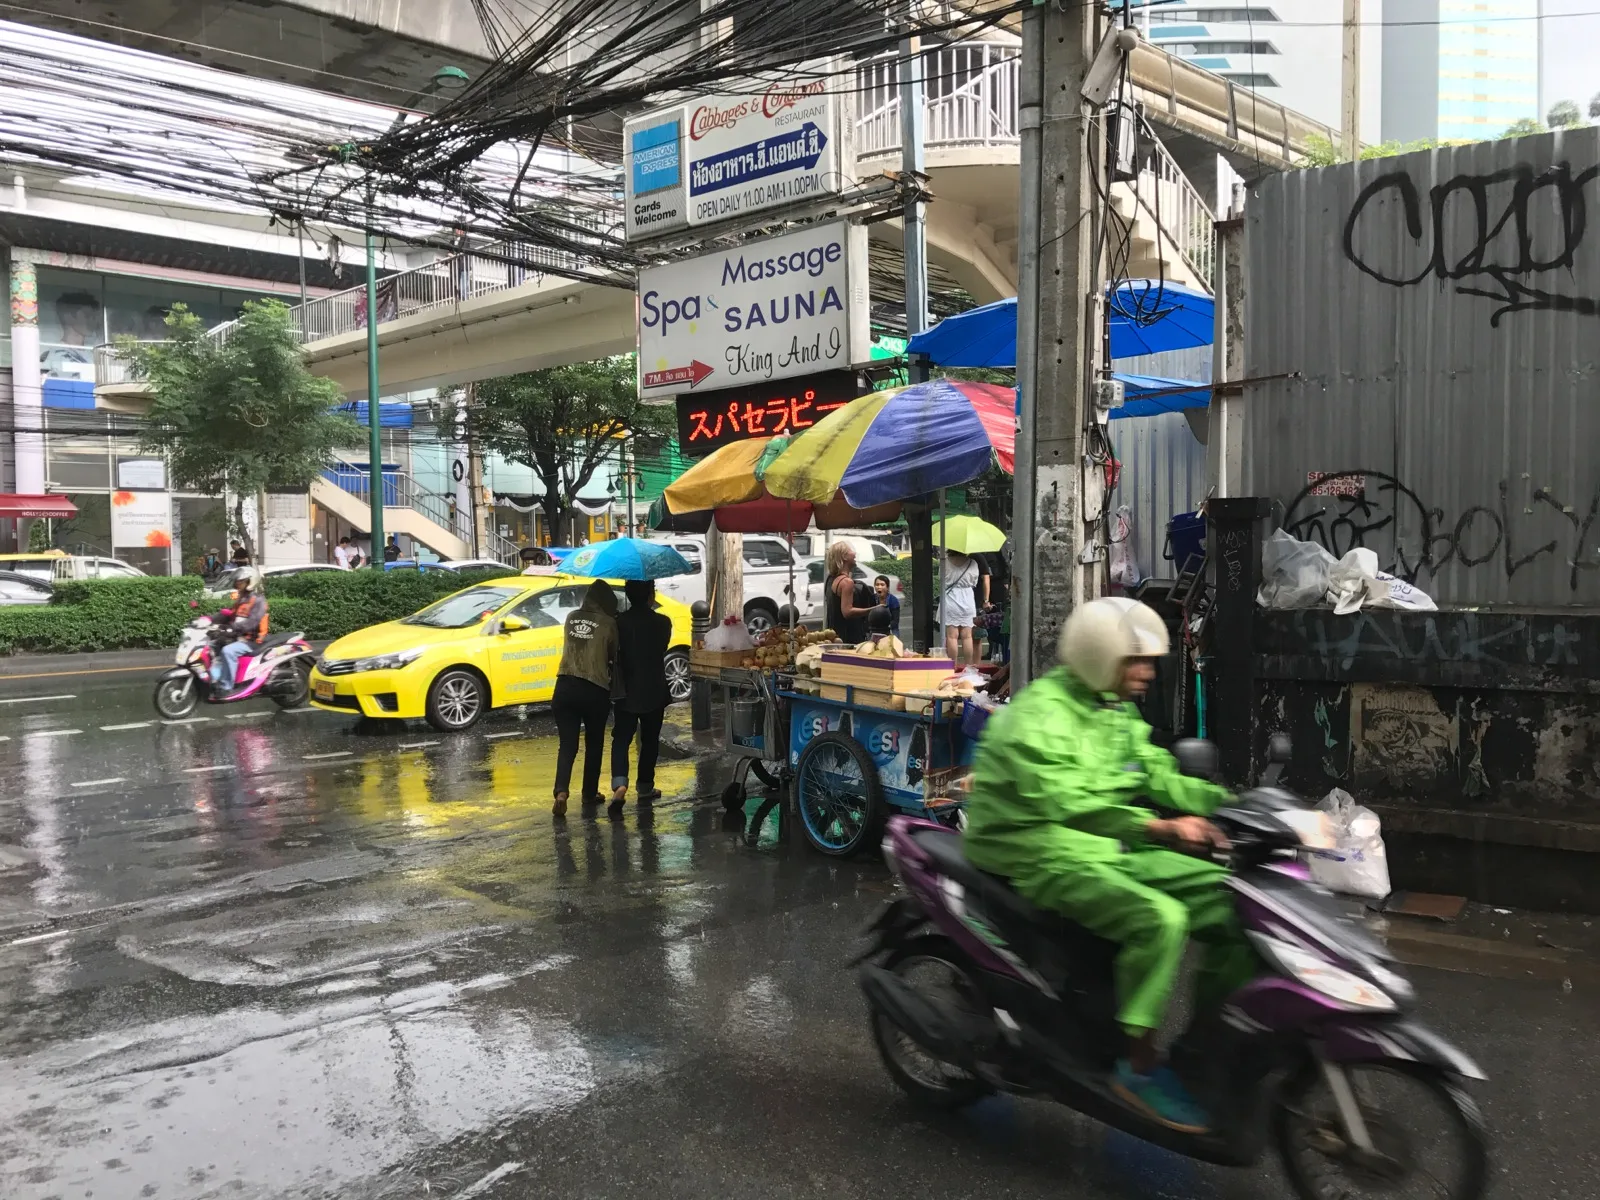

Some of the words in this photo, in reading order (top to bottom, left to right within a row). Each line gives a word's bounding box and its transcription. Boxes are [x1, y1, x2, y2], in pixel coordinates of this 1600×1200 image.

[690, 101, 748, 141] Cabbages
[750, 97, 759, 111] &
[762, 79, 825, 118] Condoms
[774, 104, 826, 127] RESTAURANT
[633, 143, 676, 162] AMERICAN
[641, 157, 679, 174] EXPRESS
[634, 200, 661, 215] Cards
[634, 208, 677, 226] Welcome
[696, 200, 718, 220] OPEN
[719, 193, 741, 216] DAILY
[743, 187, 765, 208] 11.00
[721, 242, 841, 287] Massage
[642, 291, 701, 337] Spa
[704, 294, 719, 312] &
[724, 286, 843, 333] SAUNA
[725, 343, 773, 378] King
[778, 333, 821, 368] And
[689, 390, 847, 442] スパセラピー
[801, 712, 829, 739] est
[868, 729, 899, 753] est
